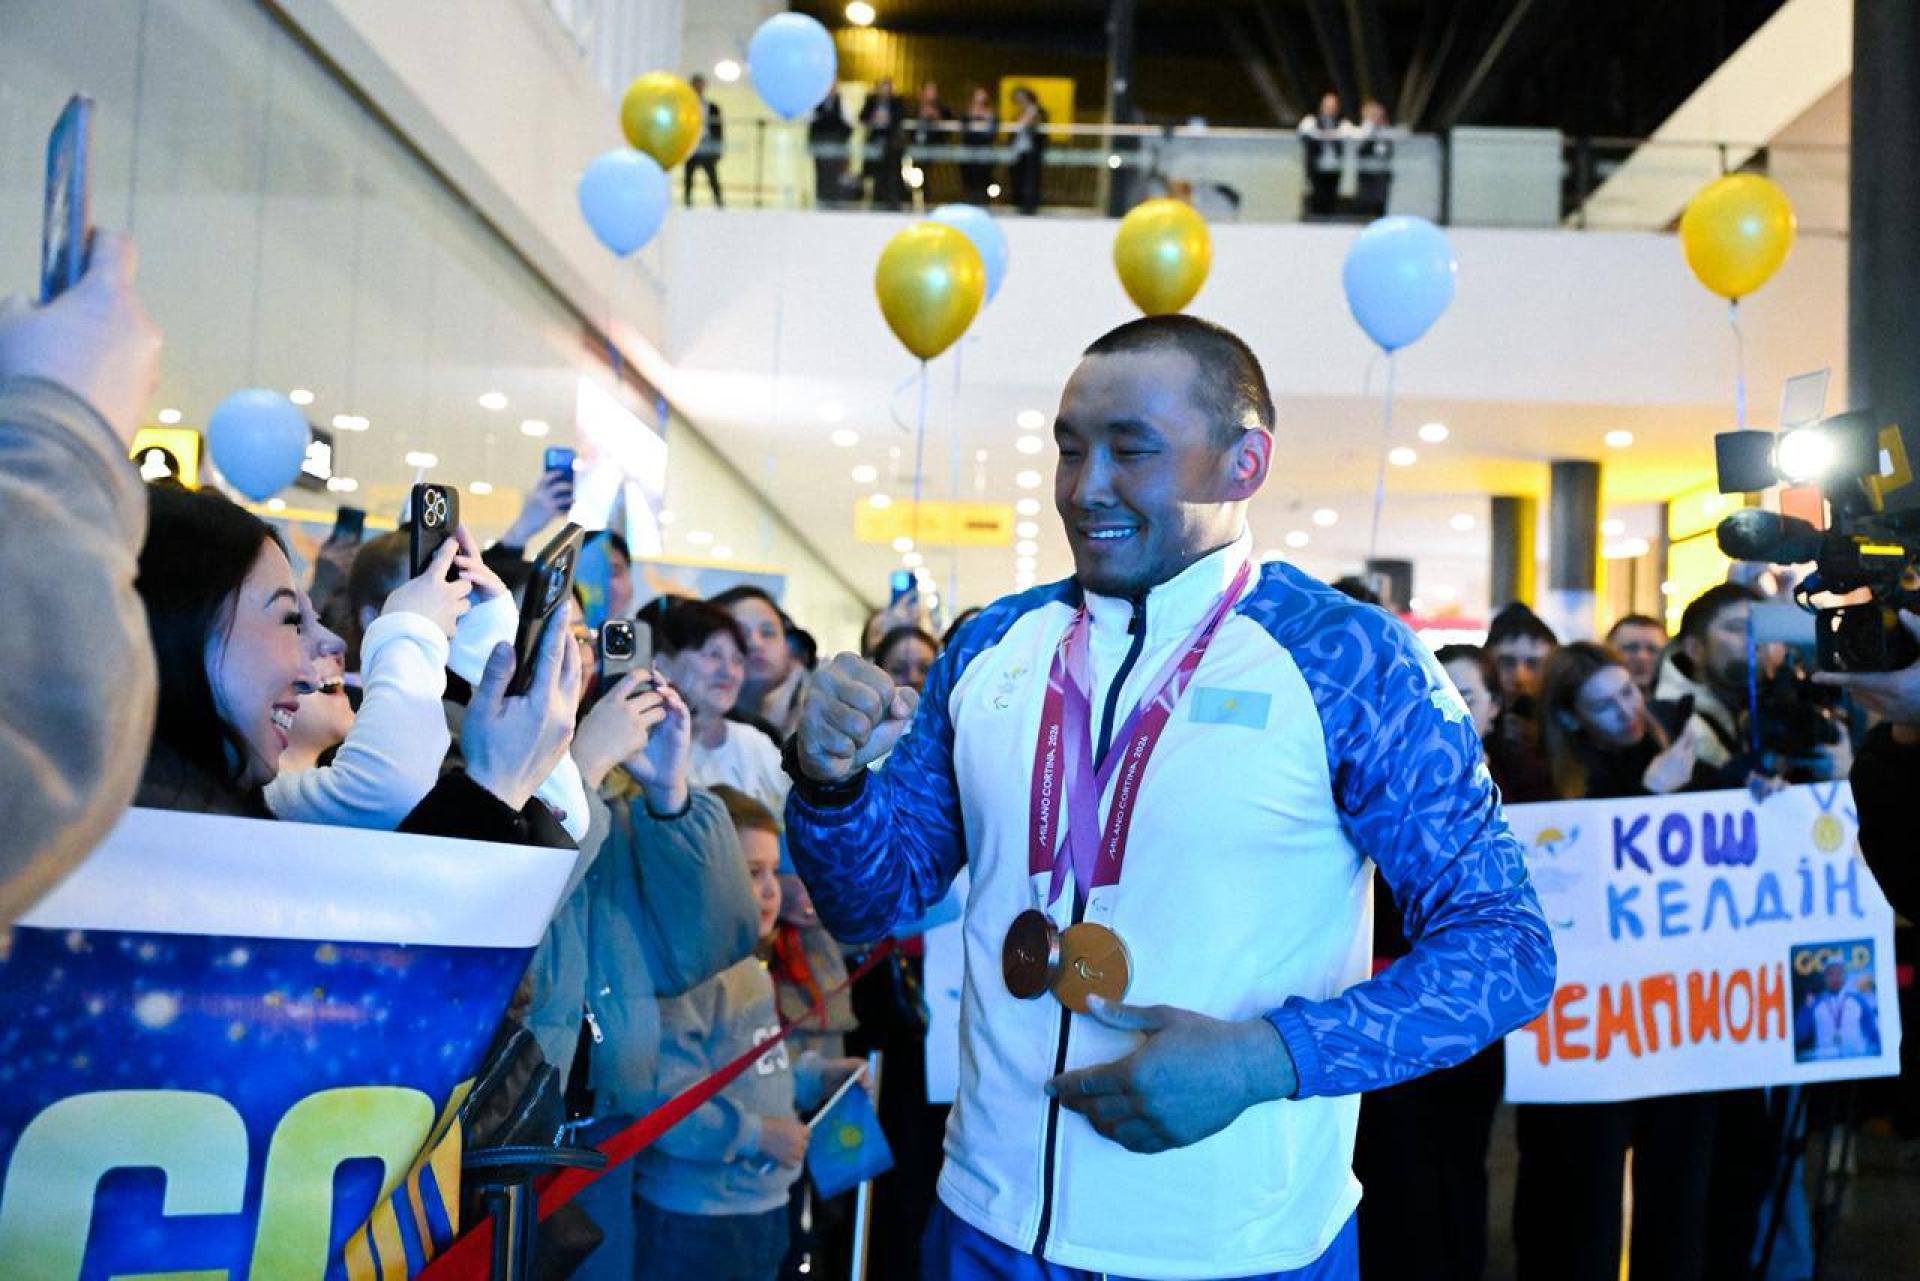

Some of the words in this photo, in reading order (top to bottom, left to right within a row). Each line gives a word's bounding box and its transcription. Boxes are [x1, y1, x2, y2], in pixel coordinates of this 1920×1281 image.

[1048, 724, 1059, 747] 2026
[1042, 748, 1056, 797] CORTINA
[1109, 811, 1125, 861] MILANO
[1118, 761, 1139, 809] CORTINA
[1133, 735, 1149, 759] 2026
[1039, 798, 1051, 848] MILANO
